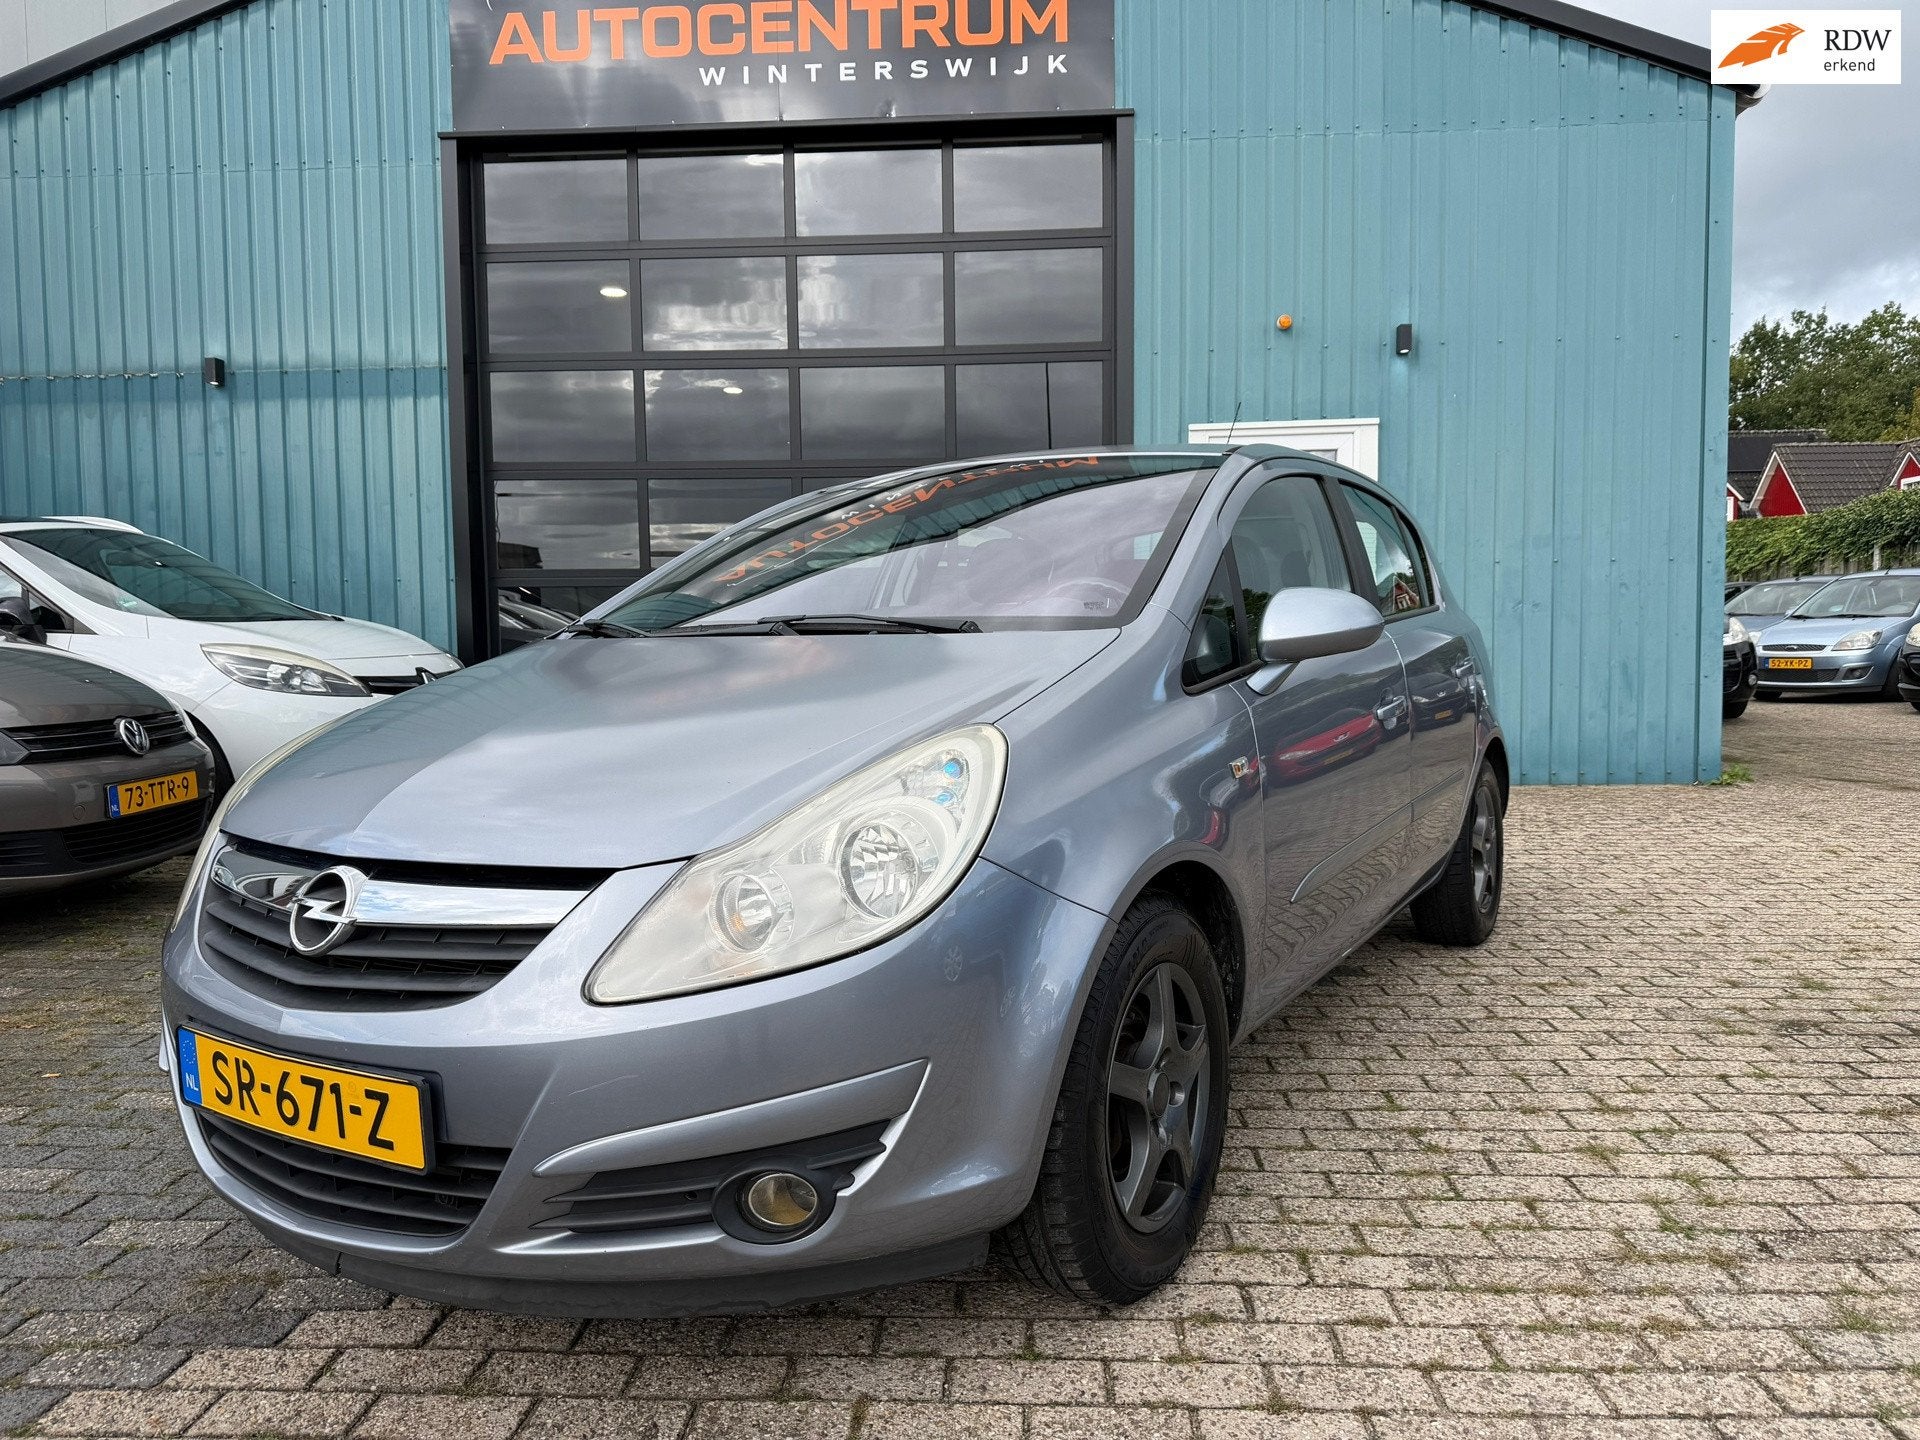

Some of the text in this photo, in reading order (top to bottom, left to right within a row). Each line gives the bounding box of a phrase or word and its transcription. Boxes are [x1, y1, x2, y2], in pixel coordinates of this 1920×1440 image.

[489, 0, 1069, 65] AUTOCENTRUM
[699, 54, 1068, 86] WINTERSWIJK
[1771, 659, 1809, 668] 52-XK-PZ
[124, 776, 189, 810] 73-TTR-9
[185, 1050, 394, 1151] NL SR-671-Z
